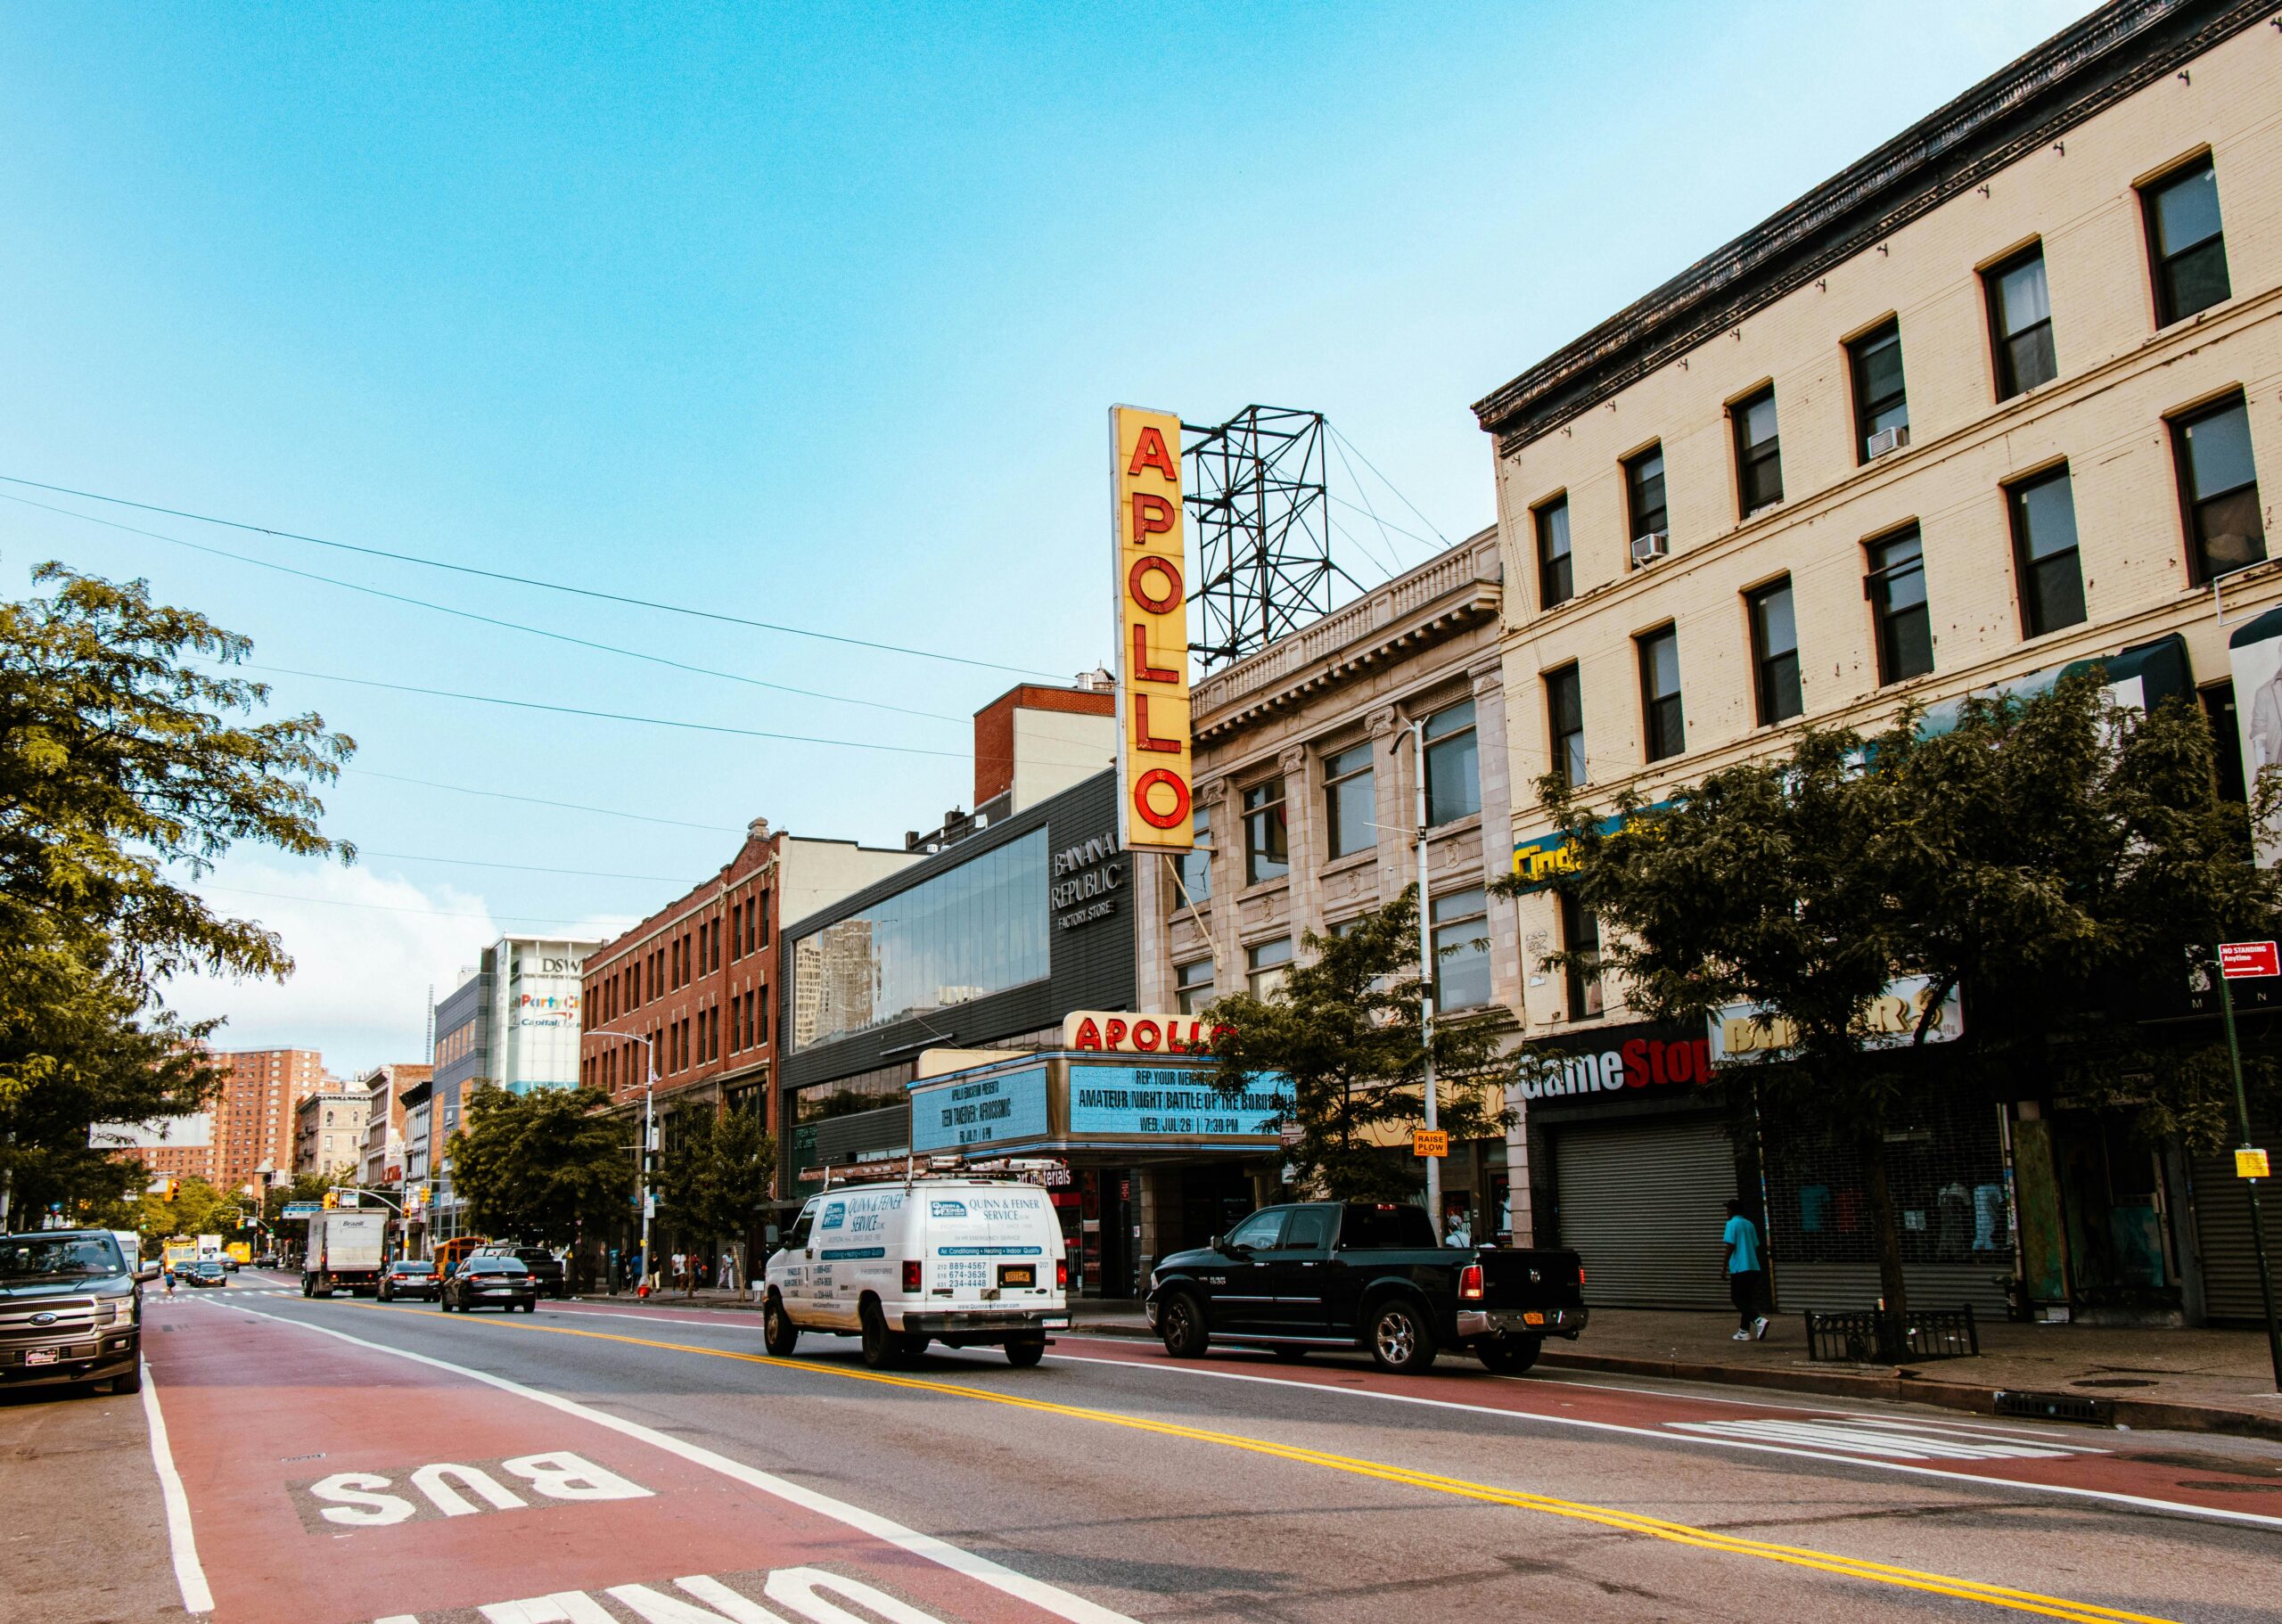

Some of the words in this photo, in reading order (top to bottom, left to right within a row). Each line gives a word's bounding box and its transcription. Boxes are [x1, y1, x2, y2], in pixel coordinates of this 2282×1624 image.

[1128, 426, 1191, 830] APOLLO
[1055, 833, 1118, 877] BANANA
[1052, 864, 1120, 910] REPUBLIC
[1058, 909, 1087, 930] FACTORY
[1088, 899, 1112, 921] STORE
[2234, 946, 2267, 954] STANDING
[543, 958, 582, 972] DSW
[2224, 955, 2252, 963] Anytime
[521, 1018, 558, 1027] Capital
[1136, 1070, 1152, 1085] REP
[1153, 1070, 1176, 1086] YOUR
[1079, 1089, 1129, 1108] AMATEUR
[1131, 1090, 1163, 1109] NIGHT
[1166, 1091, 1202, 1110] BATTLE
[1204, 1092, 1218, 1110] OF
[1220, 1093, 1238, 1111] THE
[941, 1108, 952, 1128] TEEN
[1162, 1117, 1178, 1132] JUL
[1180, 1118, 1192, 1132] 26
[1204, 1118, 1224, 1133] 7:30
[1226, 1119, 1239, 1133] PM
[1030, 1168, 1071, 1186] mterials
[849, 1197, 870, 1216] QUINN
[878, 1193, 903, 1210] FEINER
[969, 1199, 999, 1210] QUINN
[1003, 1199, 1009, 1209] &
[1012, 1199, 1039, 1209] FEINER
[851, 1214, 878, 1232] SERVICE
[983, 1210, 1019, 1220] SERVICE
[983, 1248, 1002, 1256] Heating
[1022, 1247, 1040, 1255] Quality
[948, 1261, 987, 1270] 889-4567
[948, 1270, 987, 1279] 674-3636
[948, 1279, 987, 1288] 234-4448
[957, 1302, 1021, 1310] www.QuinnandFeiner.com
[310, 1451, 656, 1526] BUS
